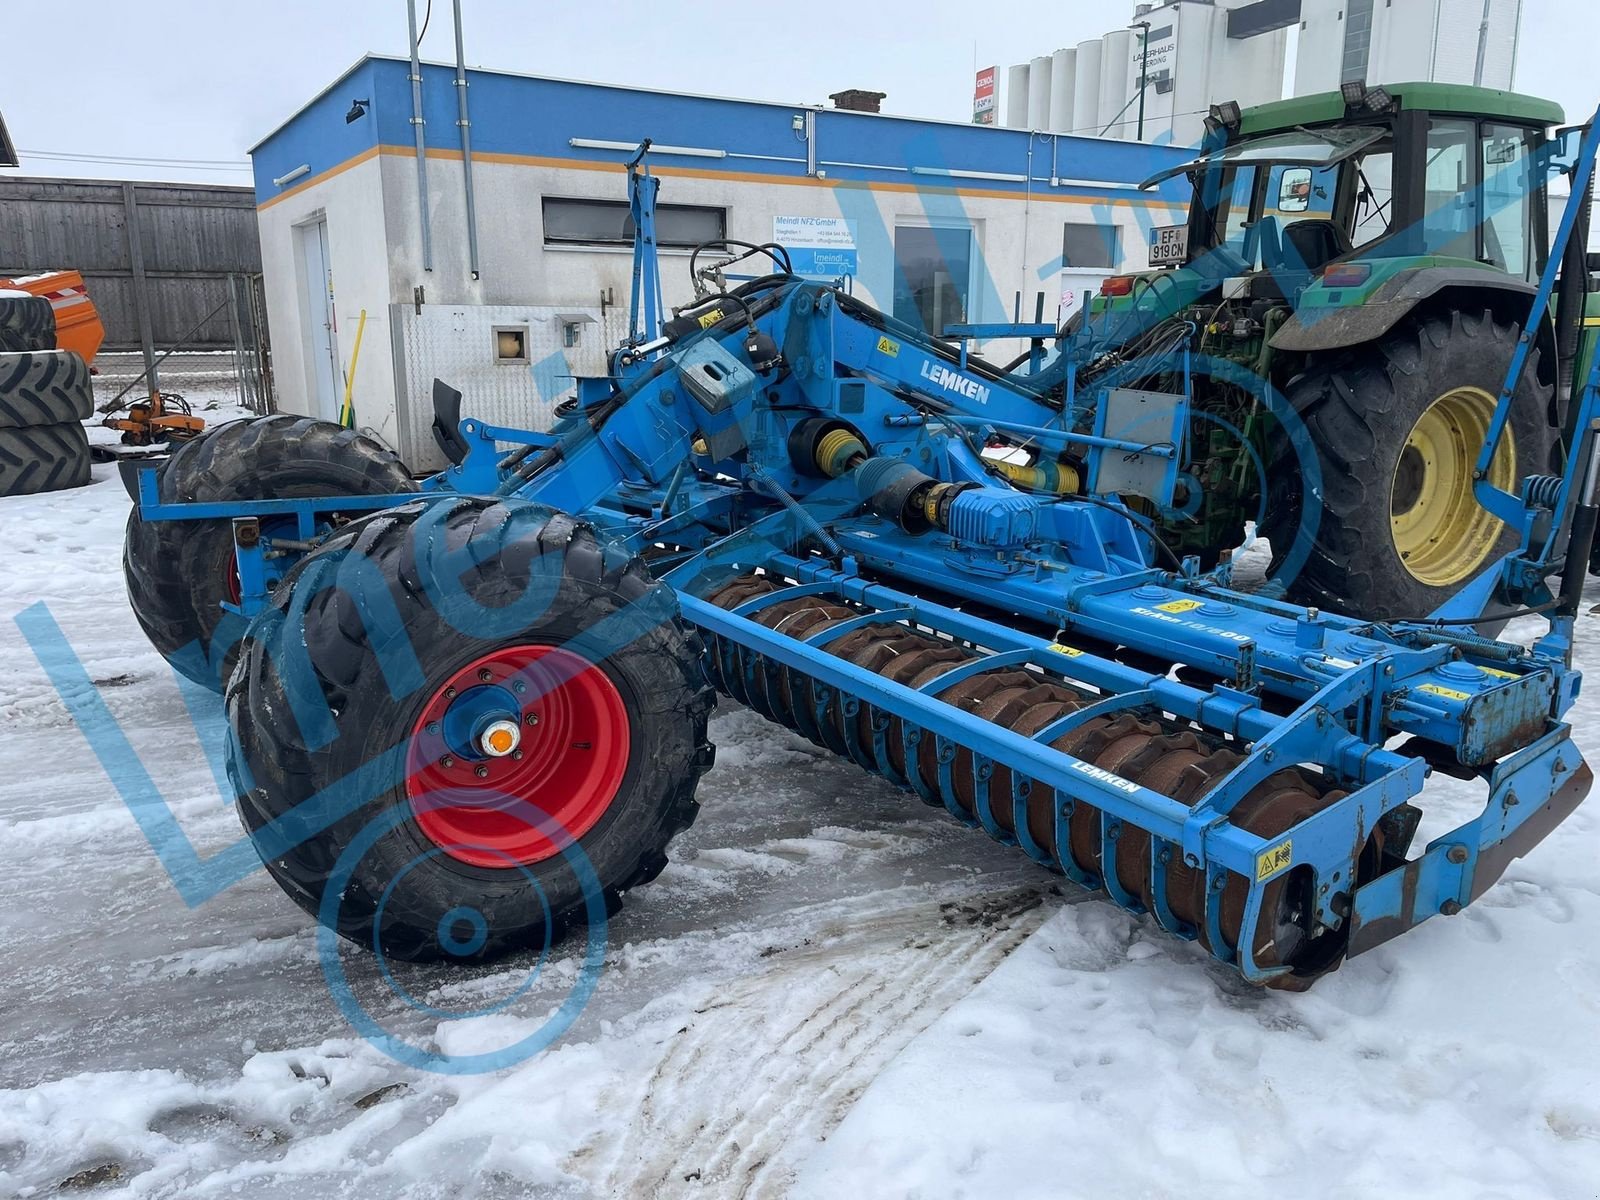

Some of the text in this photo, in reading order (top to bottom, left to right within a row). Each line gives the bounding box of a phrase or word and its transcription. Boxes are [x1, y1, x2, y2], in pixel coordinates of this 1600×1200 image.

[1140, 56, 1167, 70] EERDING
[776, 217, 799, 226] Meindl
[815, 219, 837, 227] GmbH
[1162, 230, 1174, 244] EF
[1153, 243, 1184, 258] 919 CN
[920, 360, 991, 405] LEMKEN
[1070, 761, 1143, 793] LEMKEN
